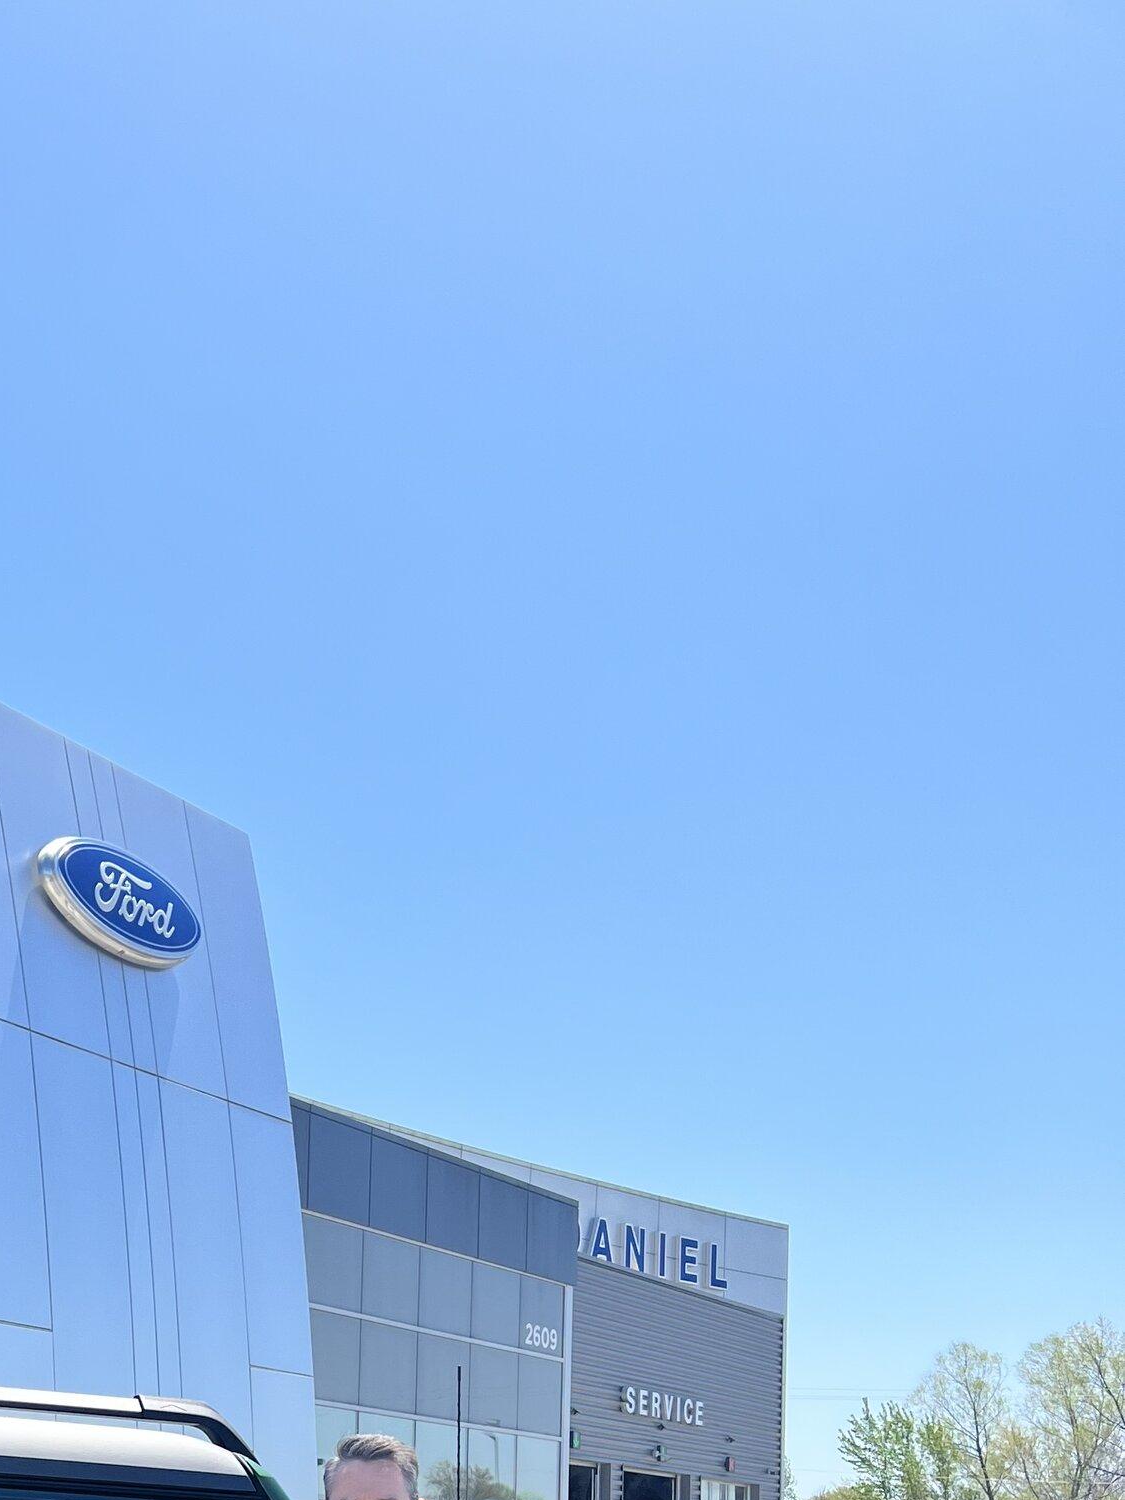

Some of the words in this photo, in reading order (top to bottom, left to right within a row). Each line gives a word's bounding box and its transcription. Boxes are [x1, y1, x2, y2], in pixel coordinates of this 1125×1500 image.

[94, 861, 175, 938] Ford
[578, 1217, 728, 1290] ANIEL
[525, 1323, 557, 1350] 2609
[626, 1386, 704, 1426] SERVICE
